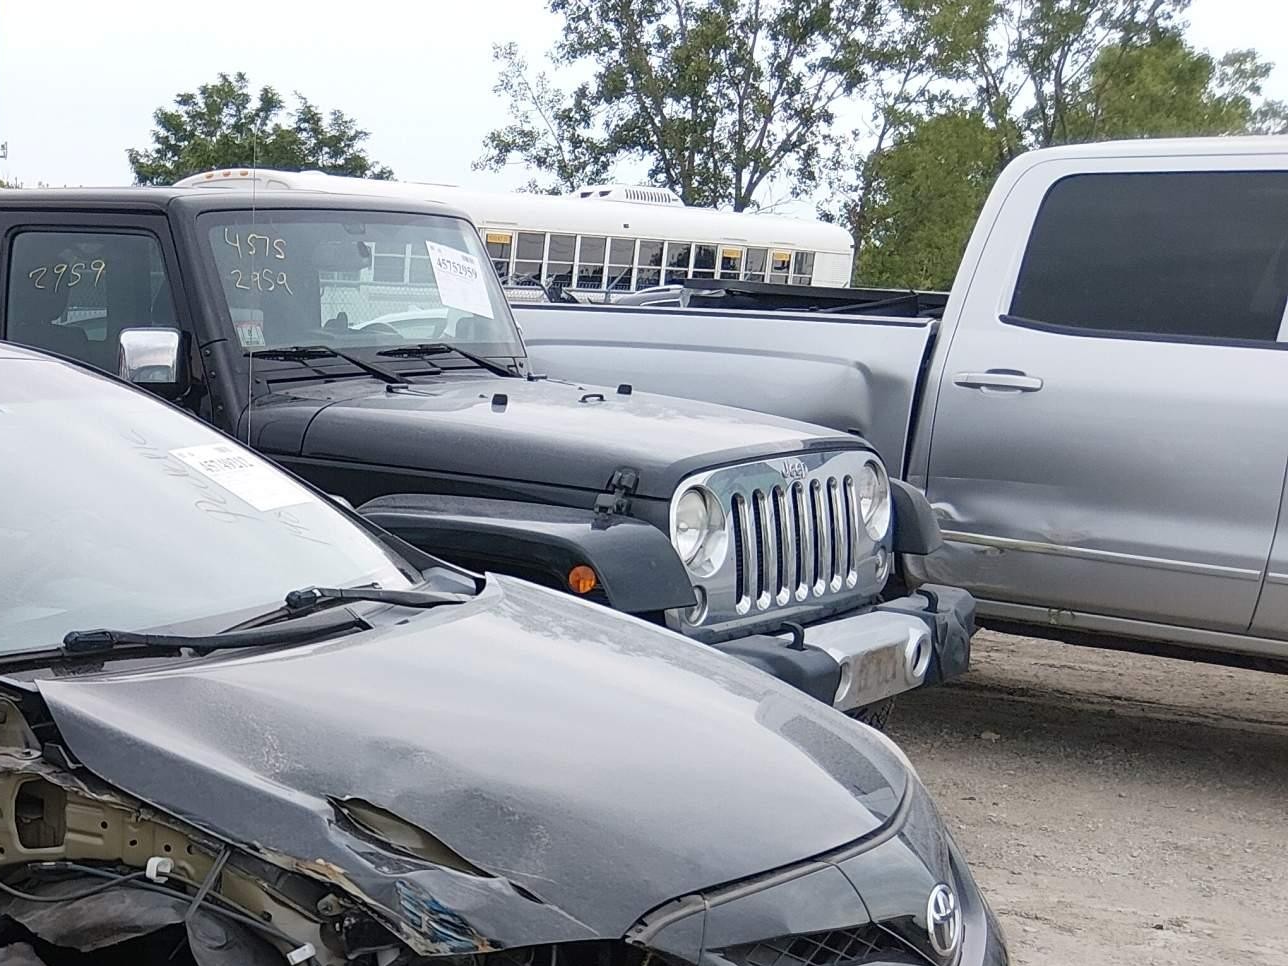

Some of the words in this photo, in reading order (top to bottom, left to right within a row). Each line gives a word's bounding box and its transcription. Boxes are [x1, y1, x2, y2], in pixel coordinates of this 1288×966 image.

[225, 227, 286, 259] 4575
[29, 259, 105, 293] 2959
[231, 268, 293, 295] 2959
[437, 257, 478, 279] 45752959
[781, 461, 809, 480] Jeep
